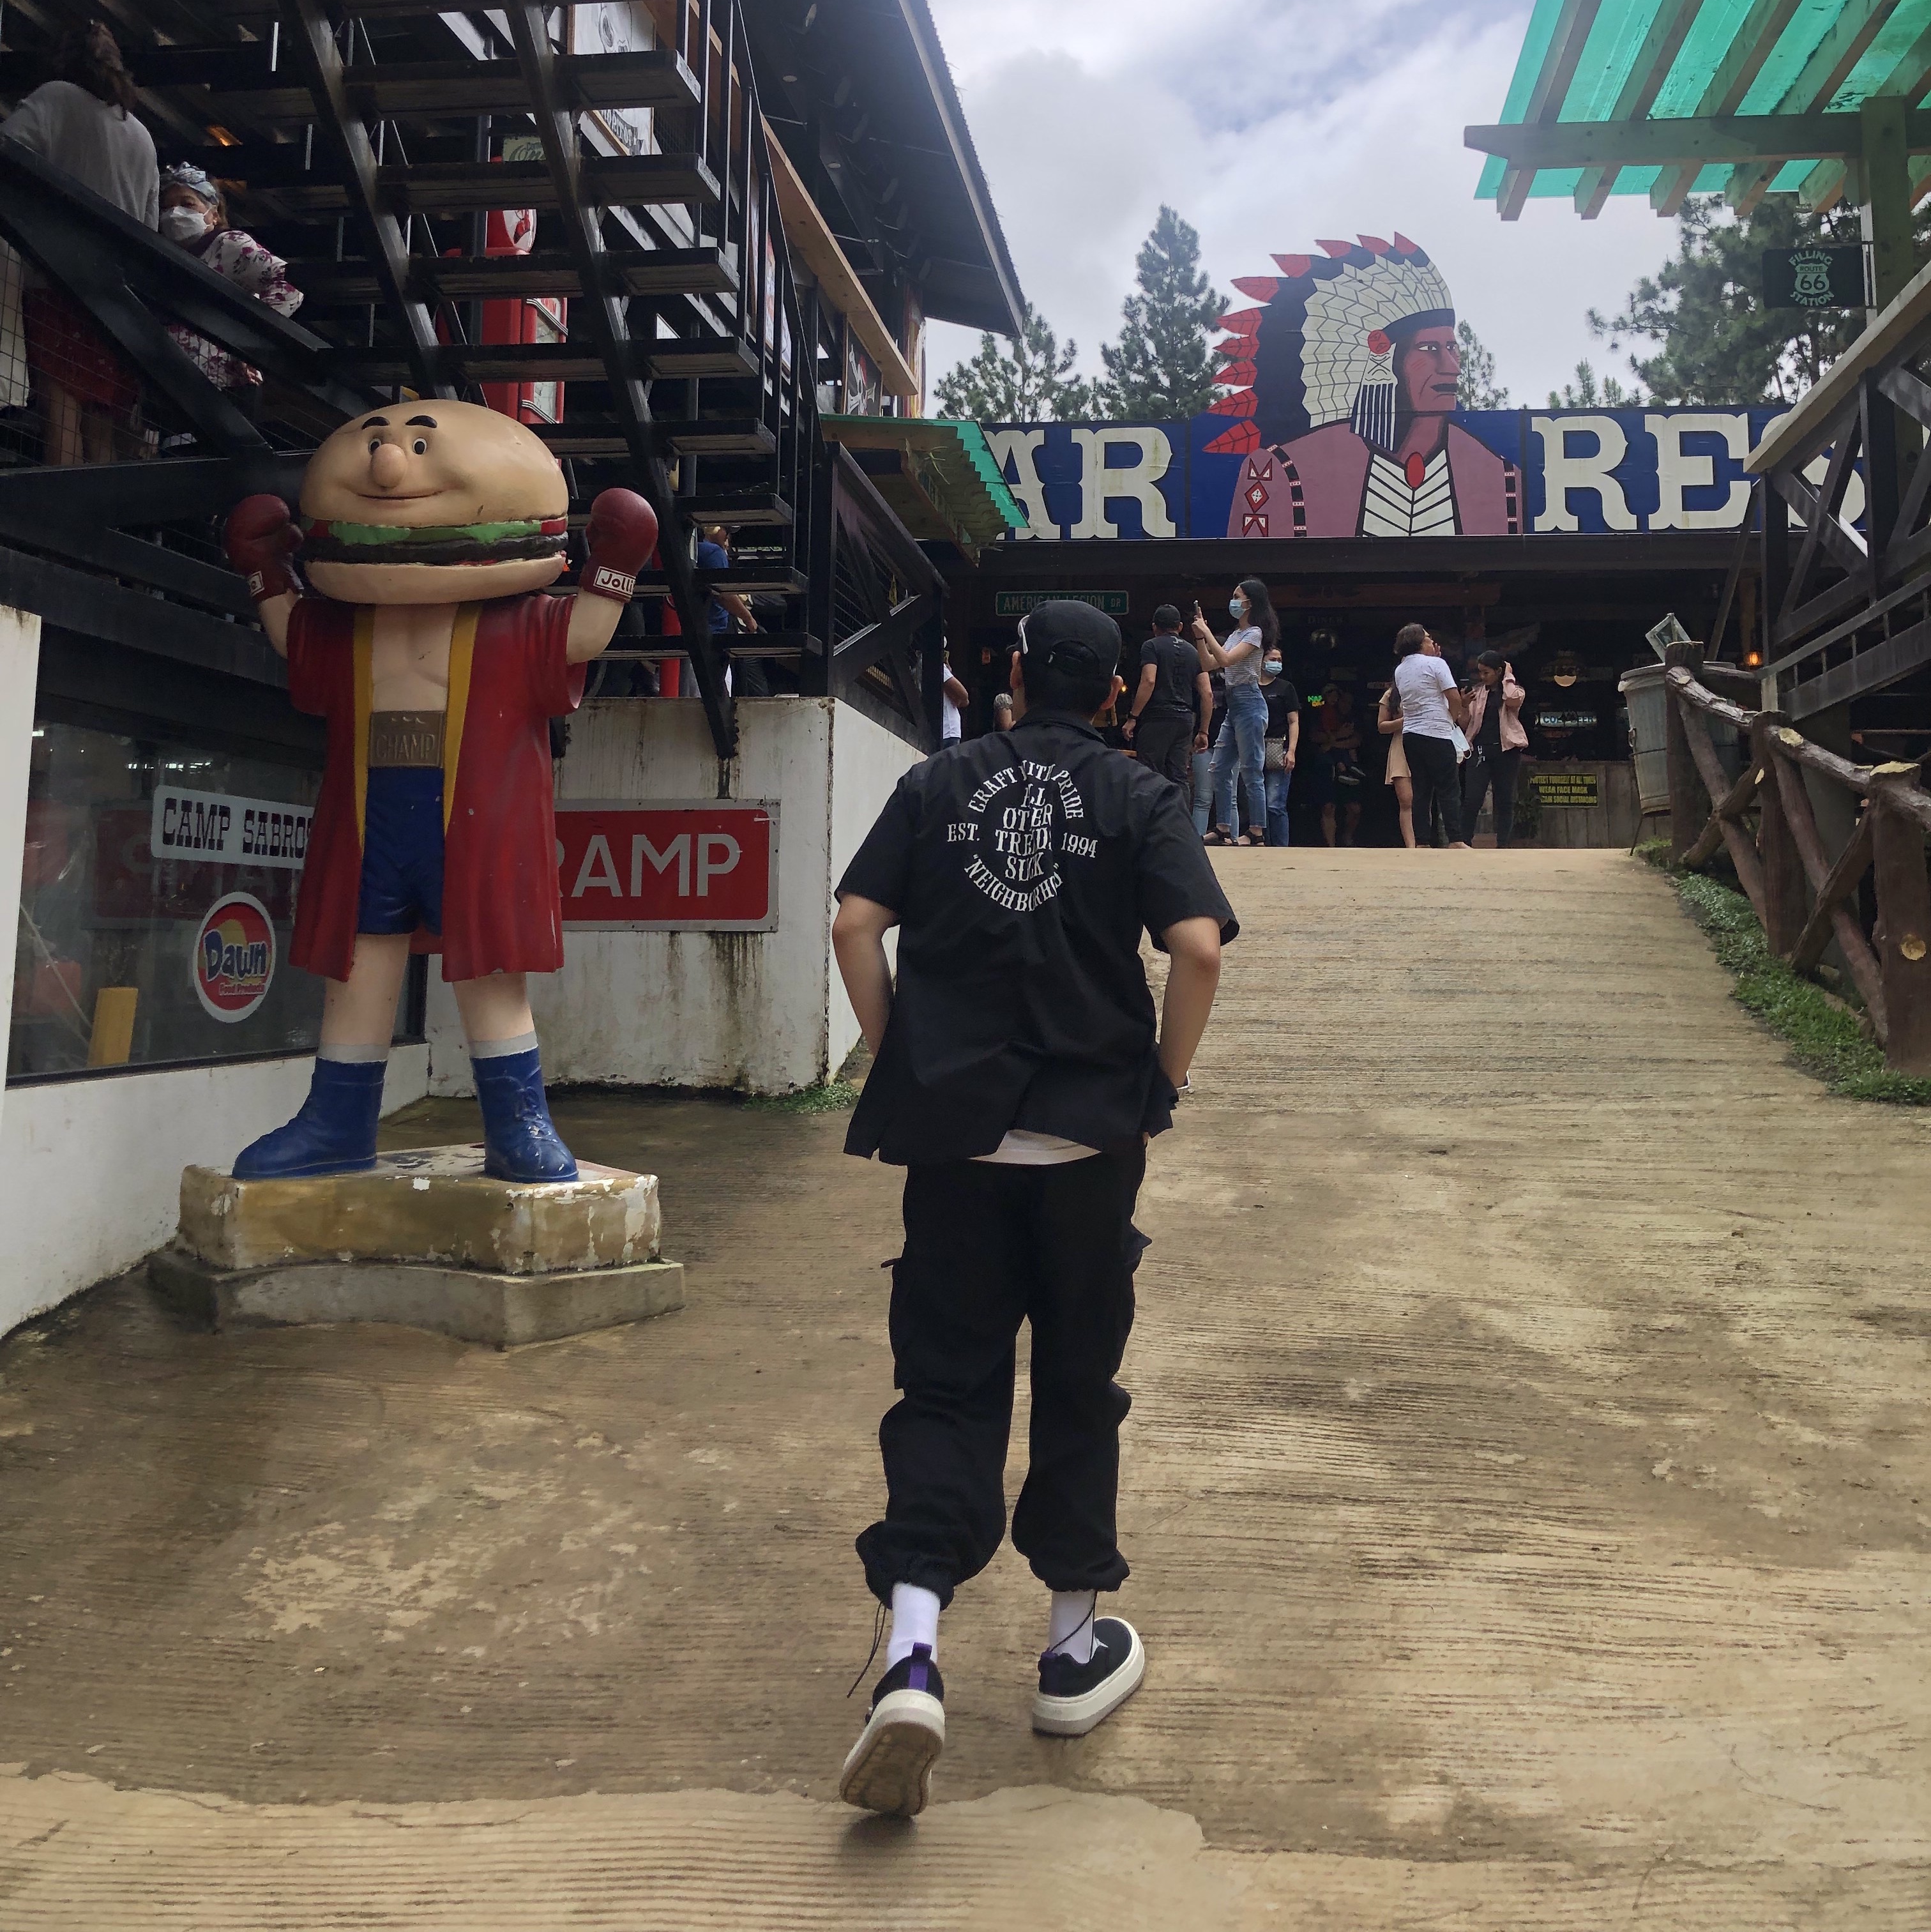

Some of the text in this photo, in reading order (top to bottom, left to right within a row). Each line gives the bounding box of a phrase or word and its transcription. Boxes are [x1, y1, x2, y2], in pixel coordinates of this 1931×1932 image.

[1789, 250, 1833, 266] FILLING
[1800, 275, 1826, 291] 66
[1790, 291, 1835, 306] STATION
[602, 574, 633, 592] Jolli
[1111, 598, 1121, 607] DR
[377, 733, 435, 760] CHAMP
[967, 767, 1017, 813] CRAFT
[162, 798, 231, 851] CAMP
[947, 823, 1098, 858] EST. 1994
[557, 833, 741, 897] AMP
[204, 929, 267, 982] Dawn
